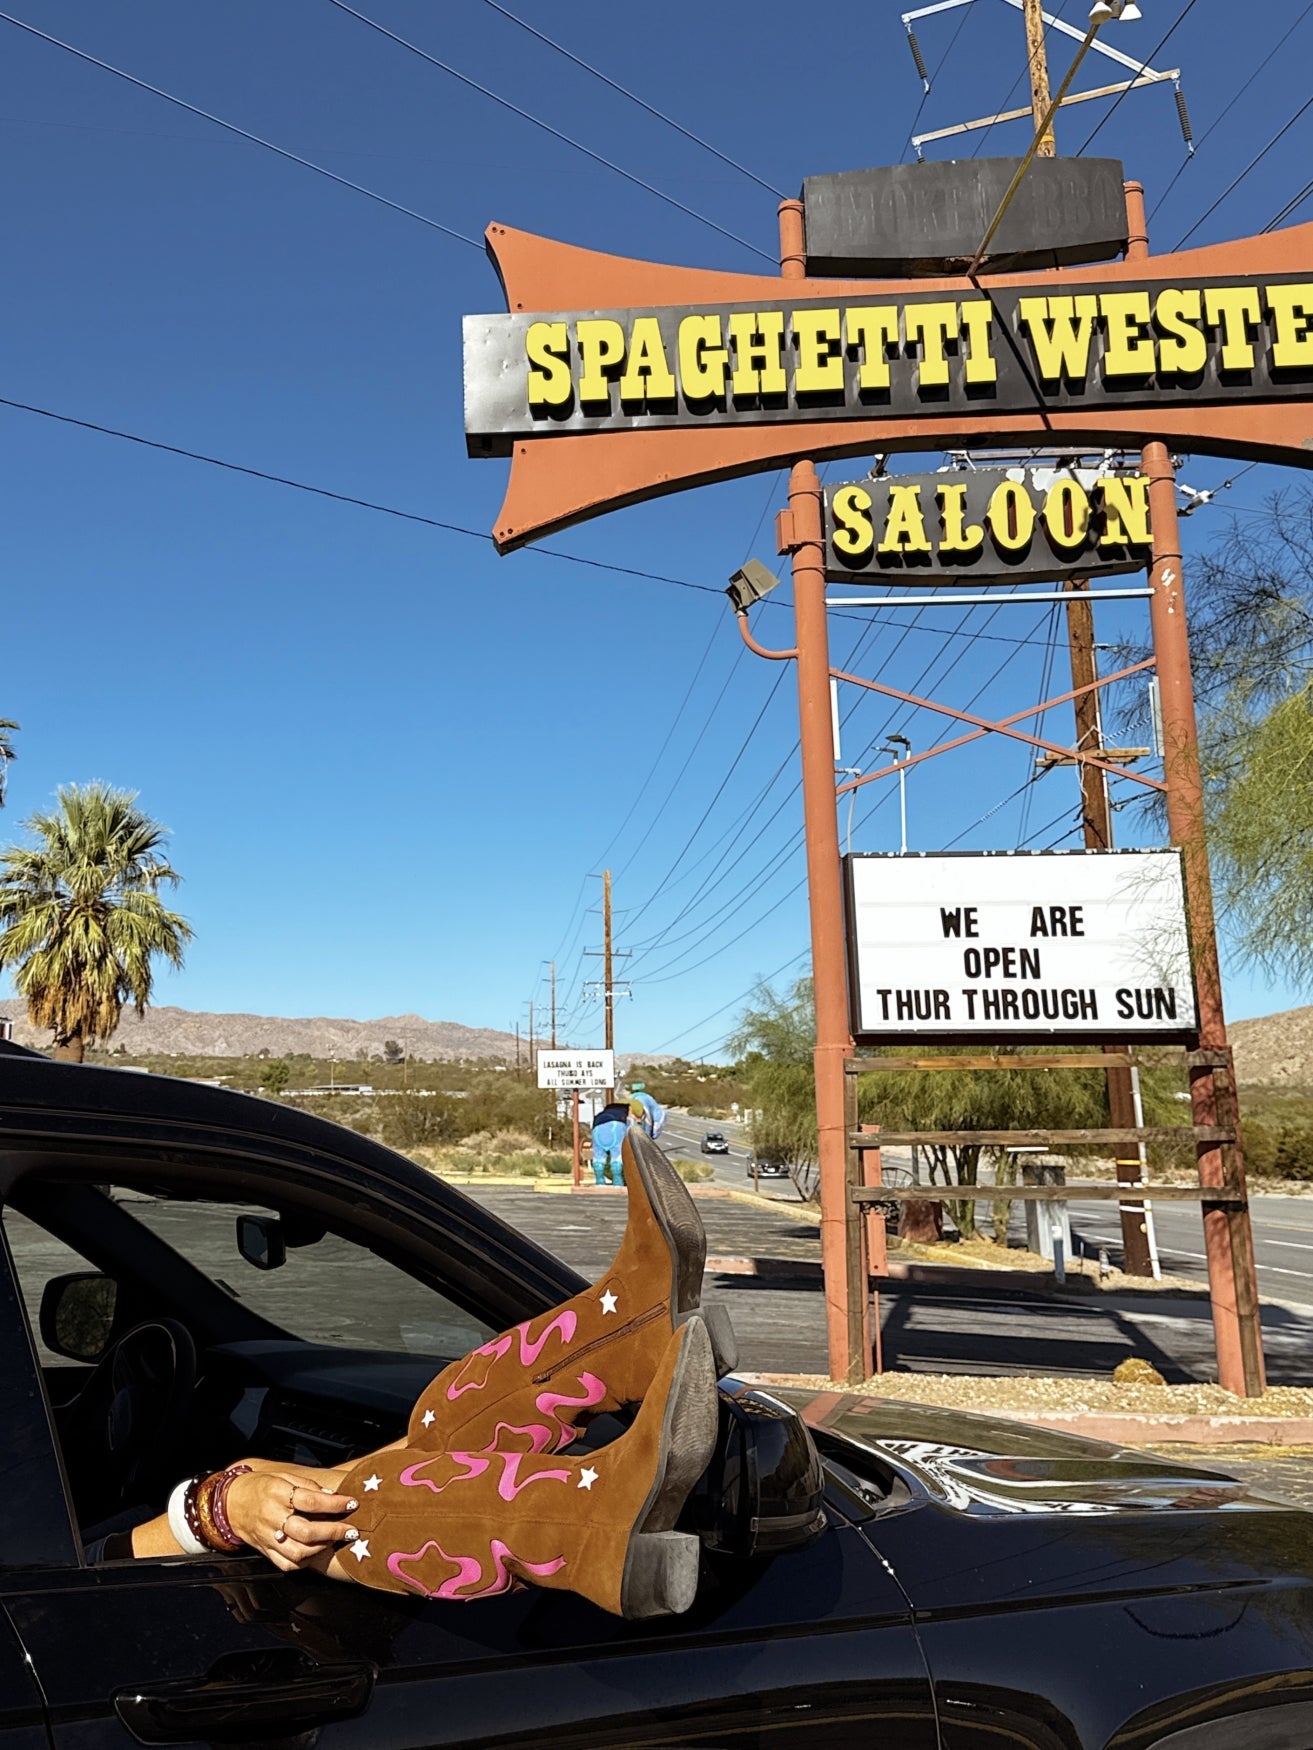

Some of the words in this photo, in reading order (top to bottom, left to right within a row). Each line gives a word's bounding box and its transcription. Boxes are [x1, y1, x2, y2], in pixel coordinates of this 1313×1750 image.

[525, 299, 998, 405] SPAGHETTI
[1018, 283, 1313, 380] WESTE
[832, 475, 1154, 555] SALOON
[940, 907, 979, 938] WE
[1030, 906, 1085, 937] ARE
[963, 947, 1041, 979] OPEN
[876, 989, 951, 1020] THUR
[962, 988, 1098, 1020] THROUGH
[1115, 987, 1177, 1020] SUN
[543, 1060, 571, 1069] LASAGNA
[576, 1060, 582, 1068] IS
[587, 1060, 604, 1069] BACK
[547, 1078, 558, 1086] ALL
[561, 1078, 586, 1086] SUMMER
[591, 1078, 607, 1086] LONG
